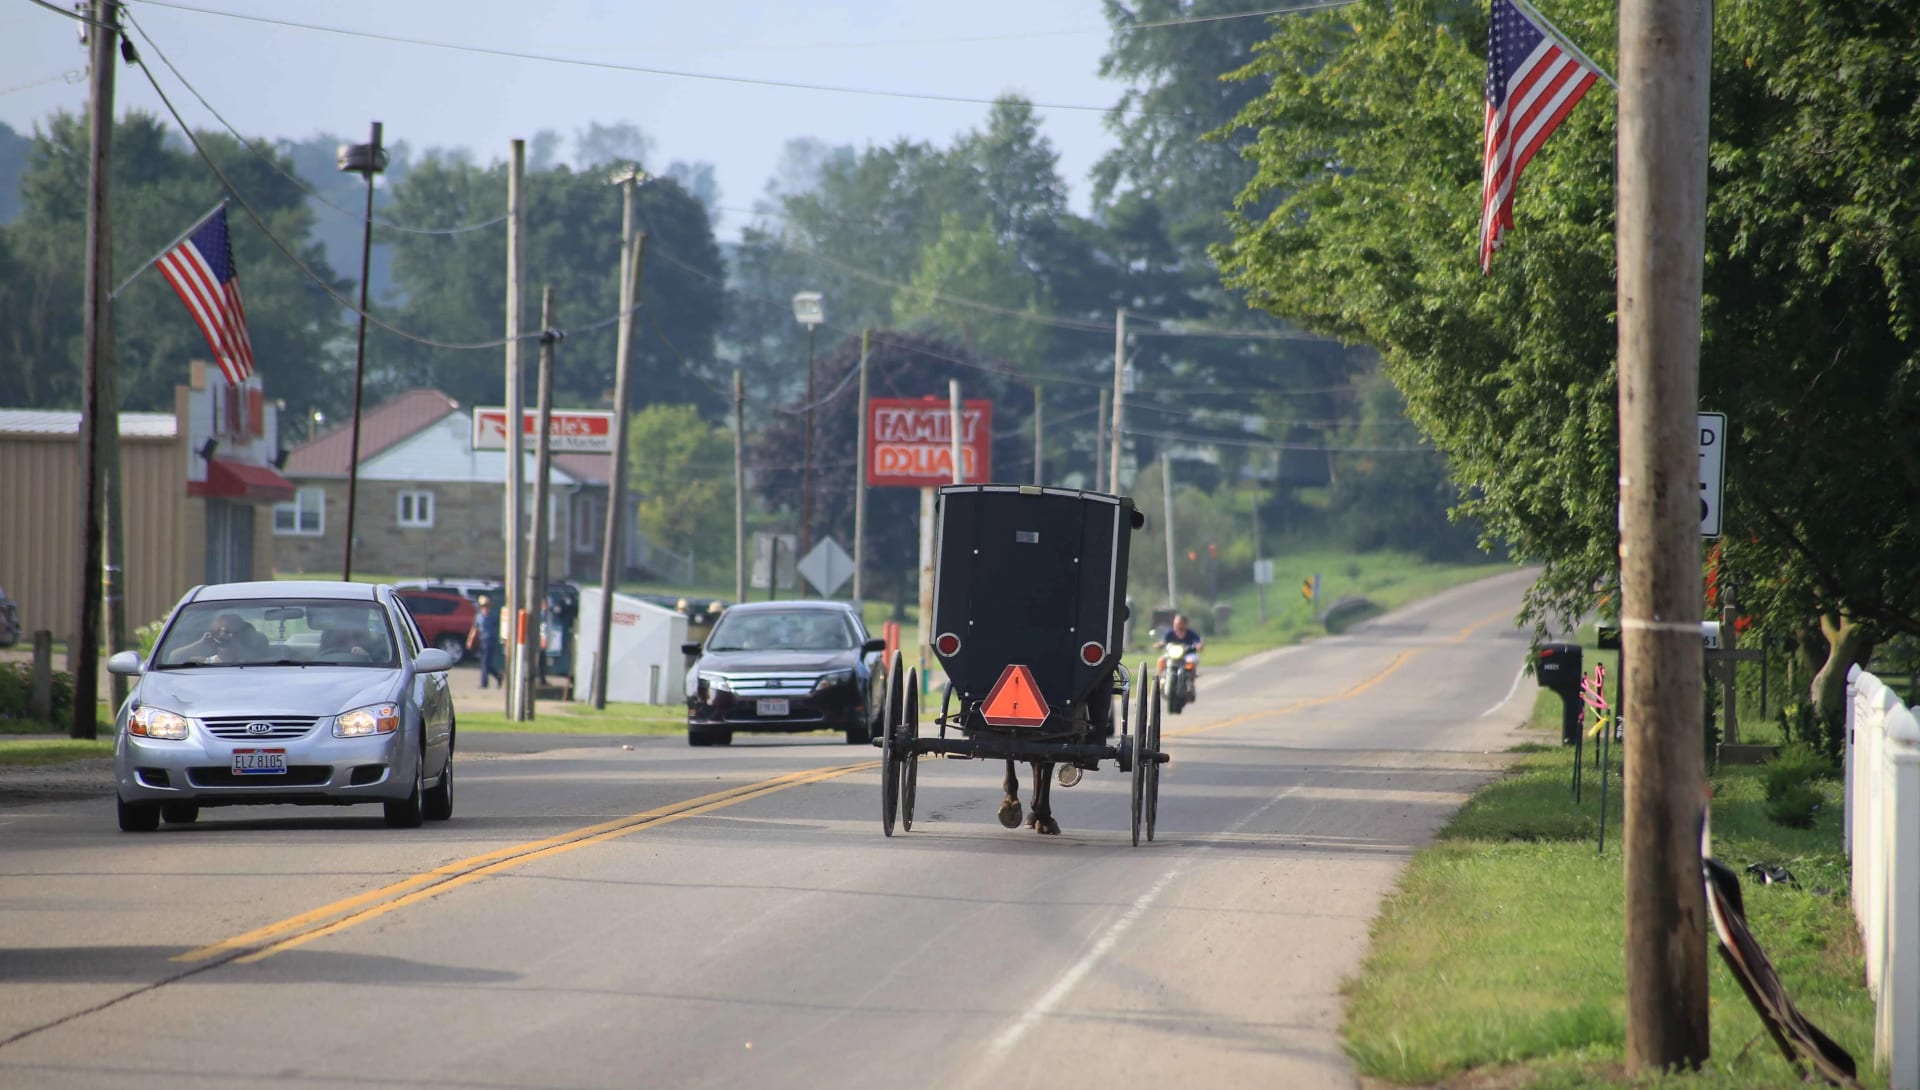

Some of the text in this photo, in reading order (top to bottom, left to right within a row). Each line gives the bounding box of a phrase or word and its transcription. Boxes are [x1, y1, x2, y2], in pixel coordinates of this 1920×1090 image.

[874, 407, 981, 442] FAMIY
[251, 724, 268, 732] KIA
[235, 754, 283, 769] ELZ 8105
